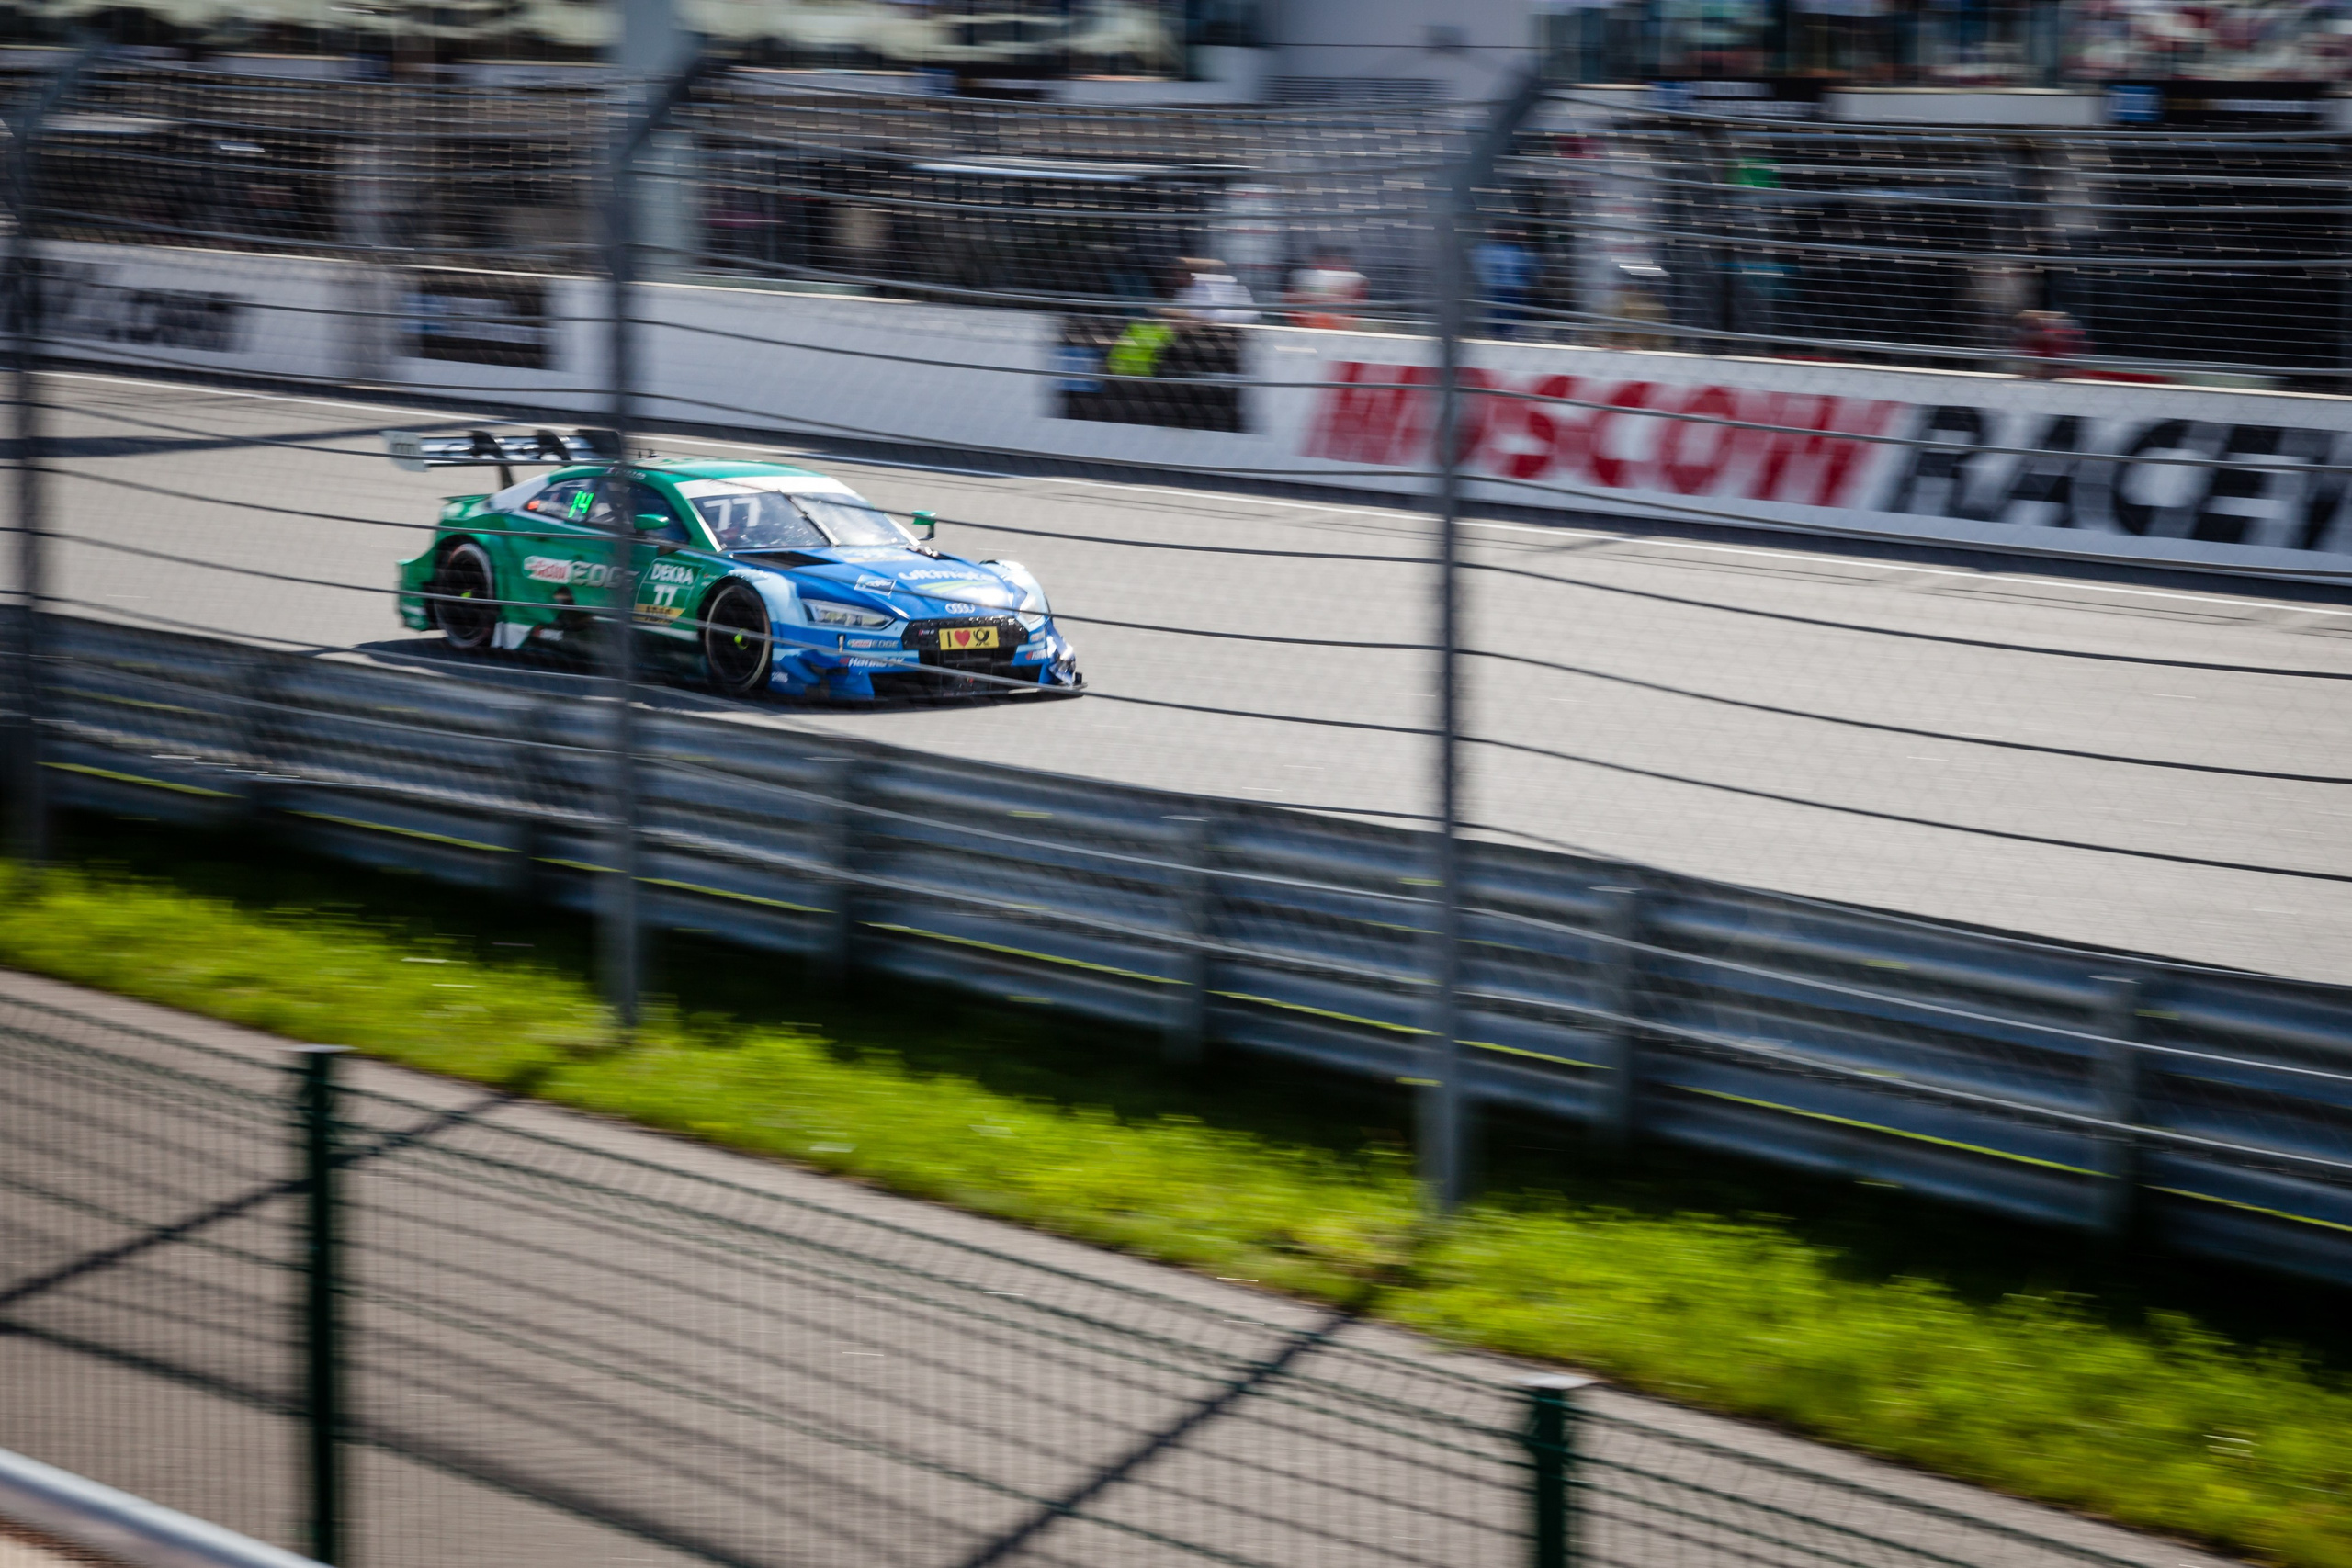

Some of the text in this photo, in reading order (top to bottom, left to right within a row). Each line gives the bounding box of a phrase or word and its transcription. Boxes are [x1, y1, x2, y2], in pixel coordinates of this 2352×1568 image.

[703, 497, 761, 532] 77
[650, 563, 694, 585] DEKRA
[653, 584, 679, 606] 77
